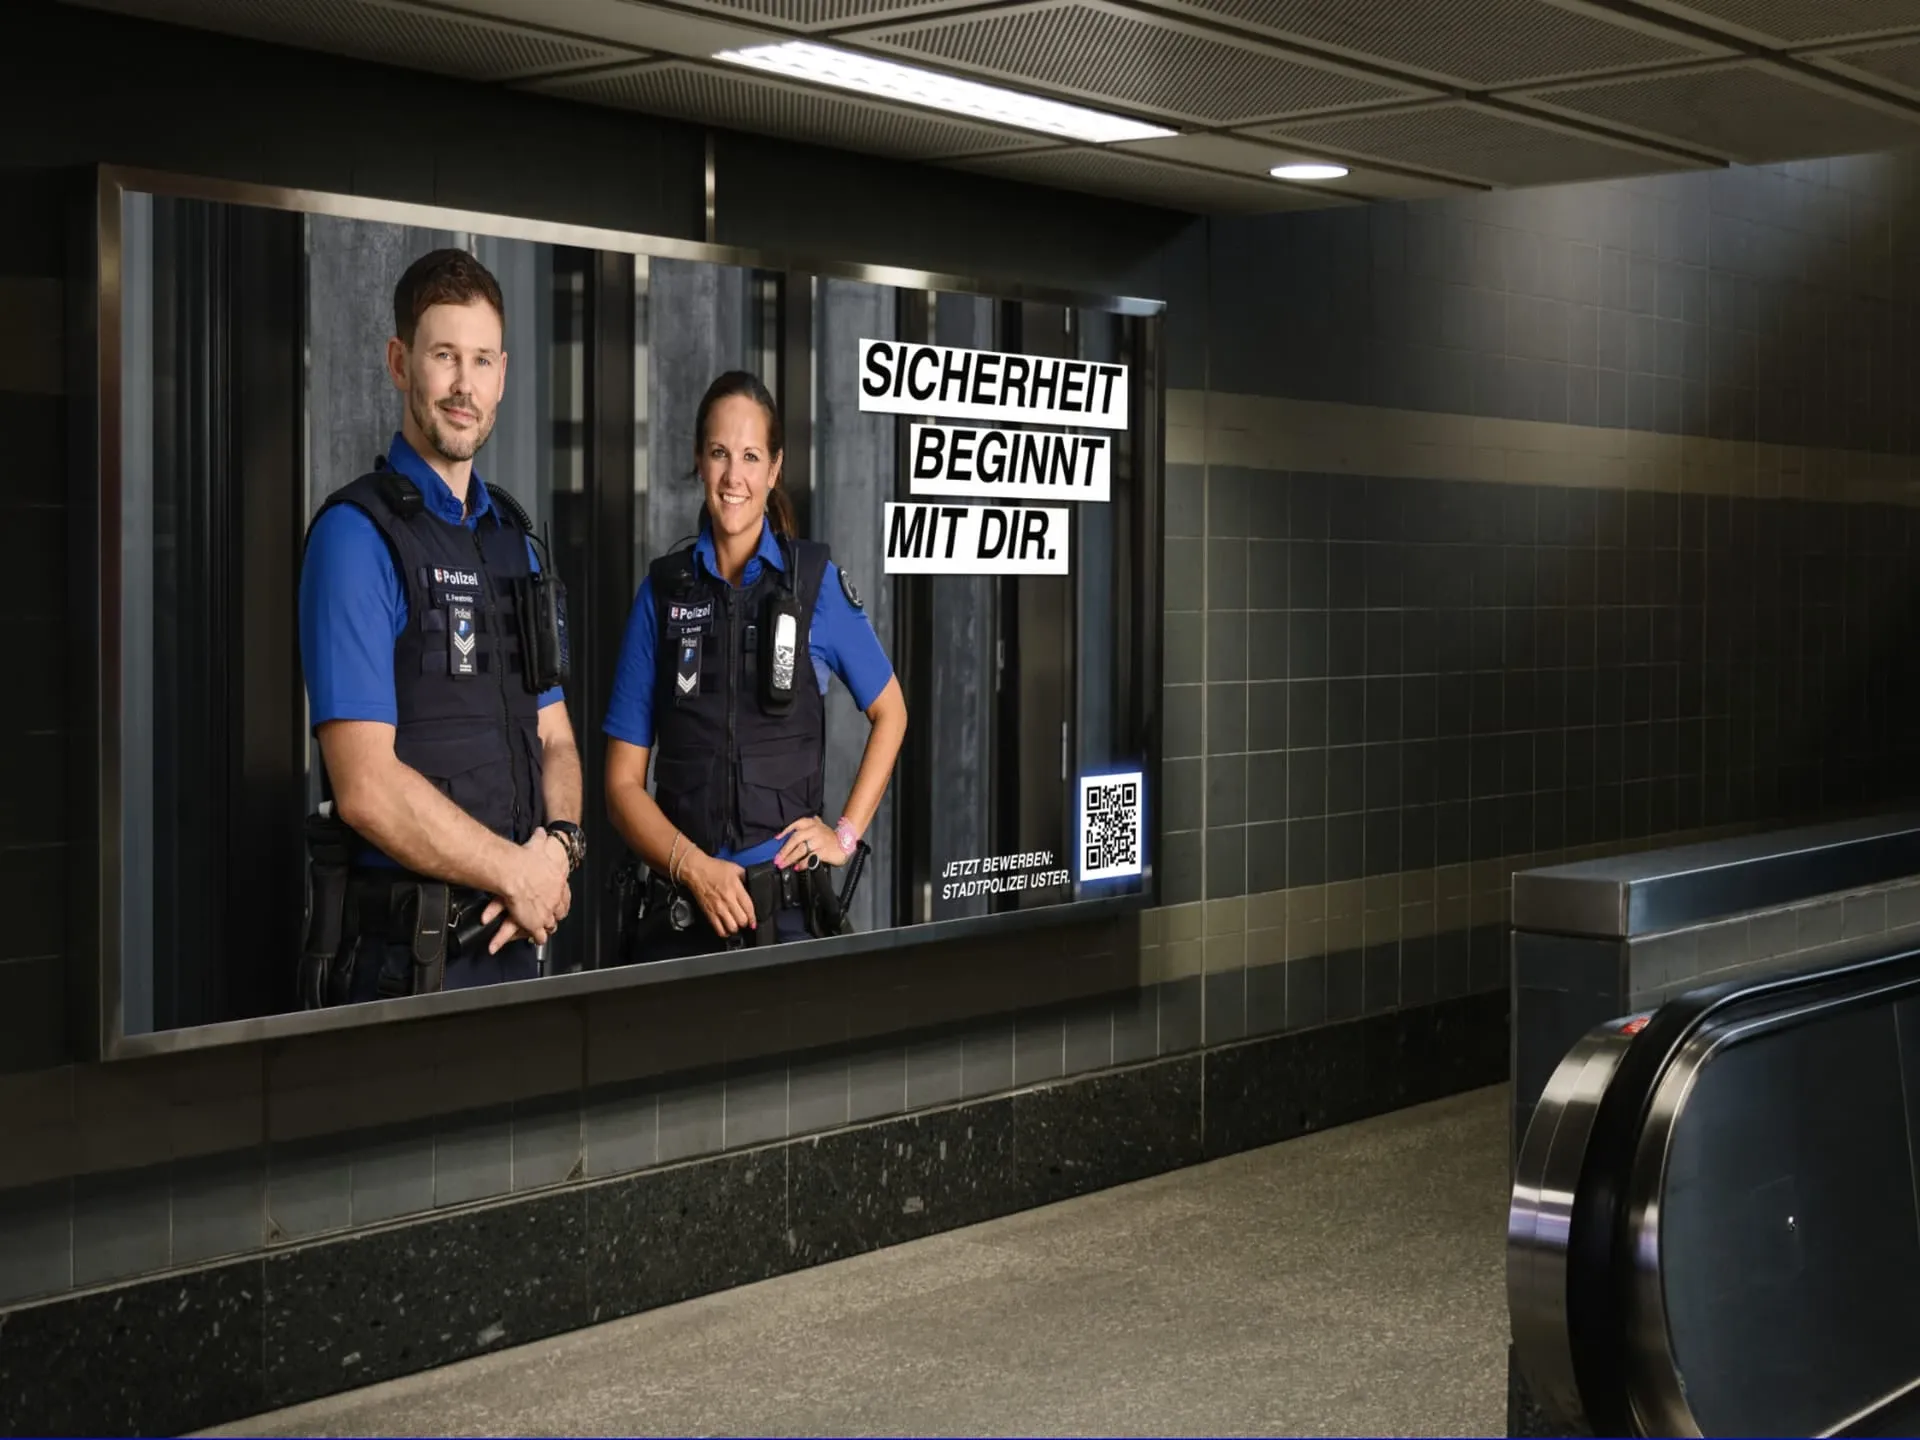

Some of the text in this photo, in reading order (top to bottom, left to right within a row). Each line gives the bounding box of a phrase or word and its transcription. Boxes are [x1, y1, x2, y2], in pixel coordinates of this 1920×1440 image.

[862, 342, 1122, 414] SICHERHEIT
[913, 427, 1105, 486] BEGINNT
[887, 506, 1056, 560] MIT DIR.
[443, 570, 478, 585] Polizei
[680, 603, 710, 620] Polizei
[942, 850, 1054, 877] JETZT BEWERBEN:
[942, 869, 1071, 900] STADTPOLIZEI USTER.
